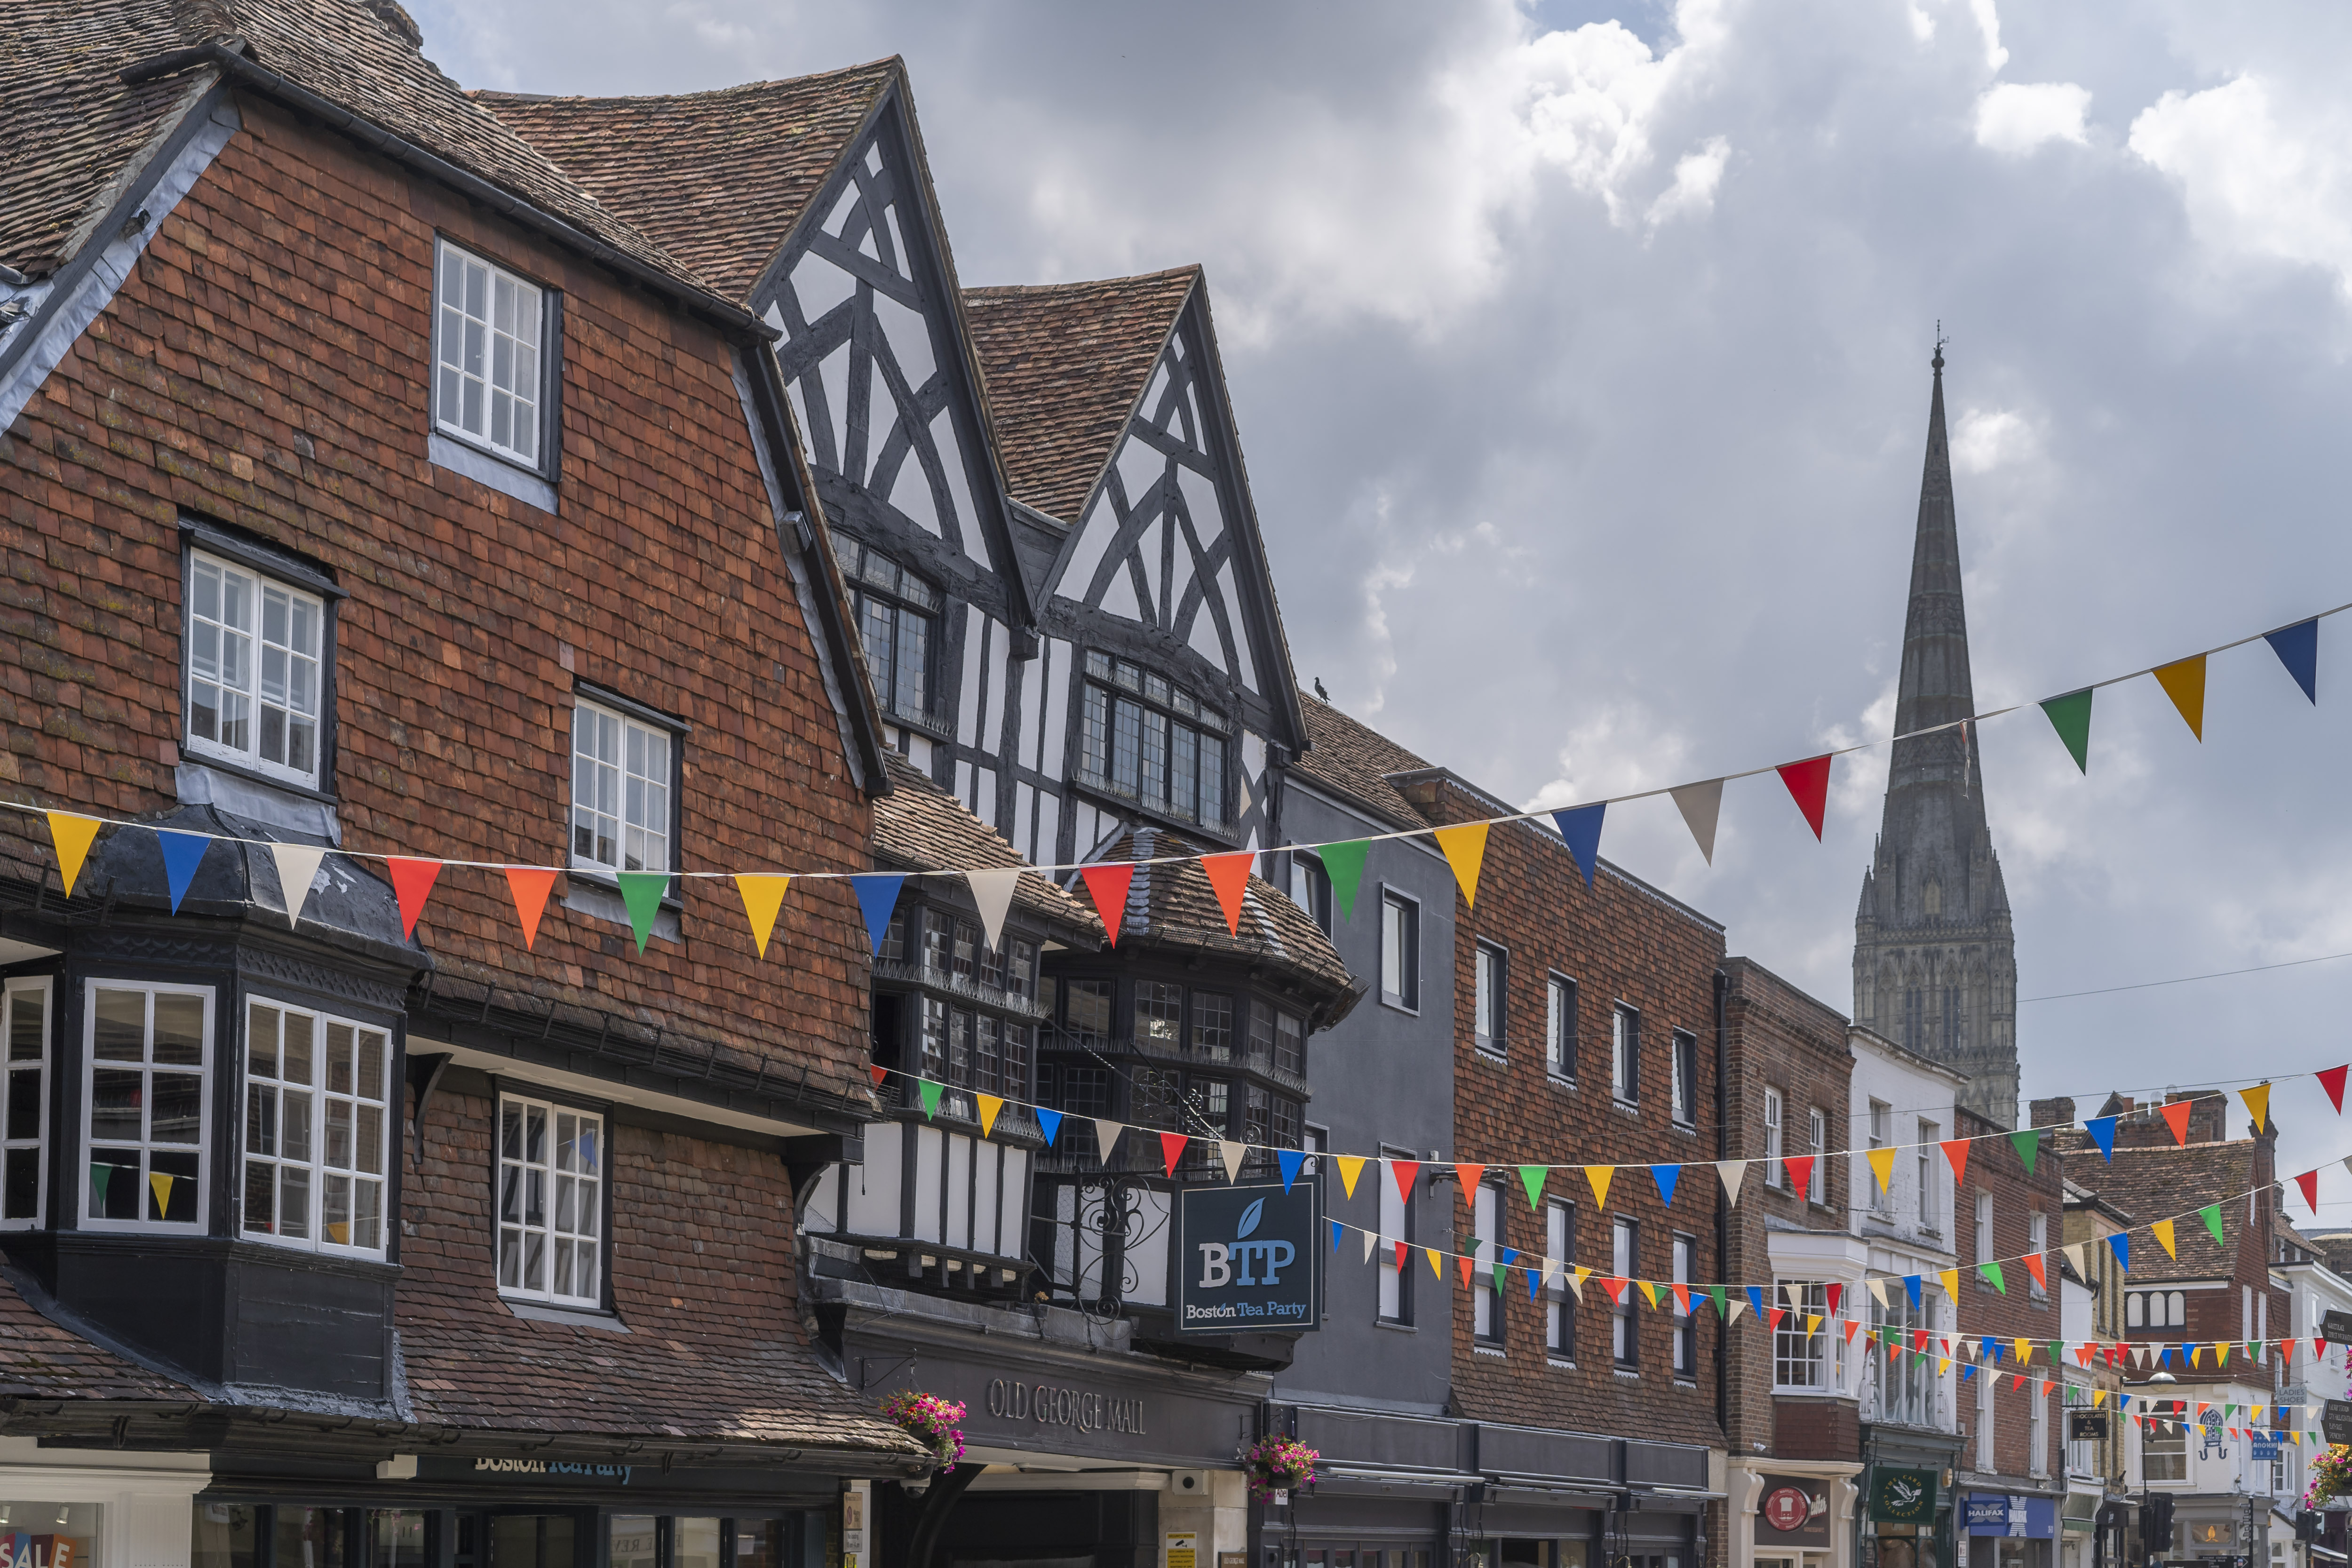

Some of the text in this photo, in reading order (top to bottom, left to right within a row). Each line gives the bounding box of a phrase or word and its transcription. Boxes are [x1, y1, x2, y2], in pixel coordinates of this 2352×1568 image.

[1199, 1240, 1295, 1288] BTP
[1186, 1301, 1306, 1319] Boston Tea Party
[990, 1378, 1146, 1434] OLD GEORGE MALL
[1884, 1475, 1922, 1490] THE CARD
[1883, 1495, 1923, 1517] COLLECTION
[2008, 1509, 2027, 1523] HALIFAX
[1768, 1514, 1780, 1527] SUNDAES
[0, 1542, 70, 1568] SALE
